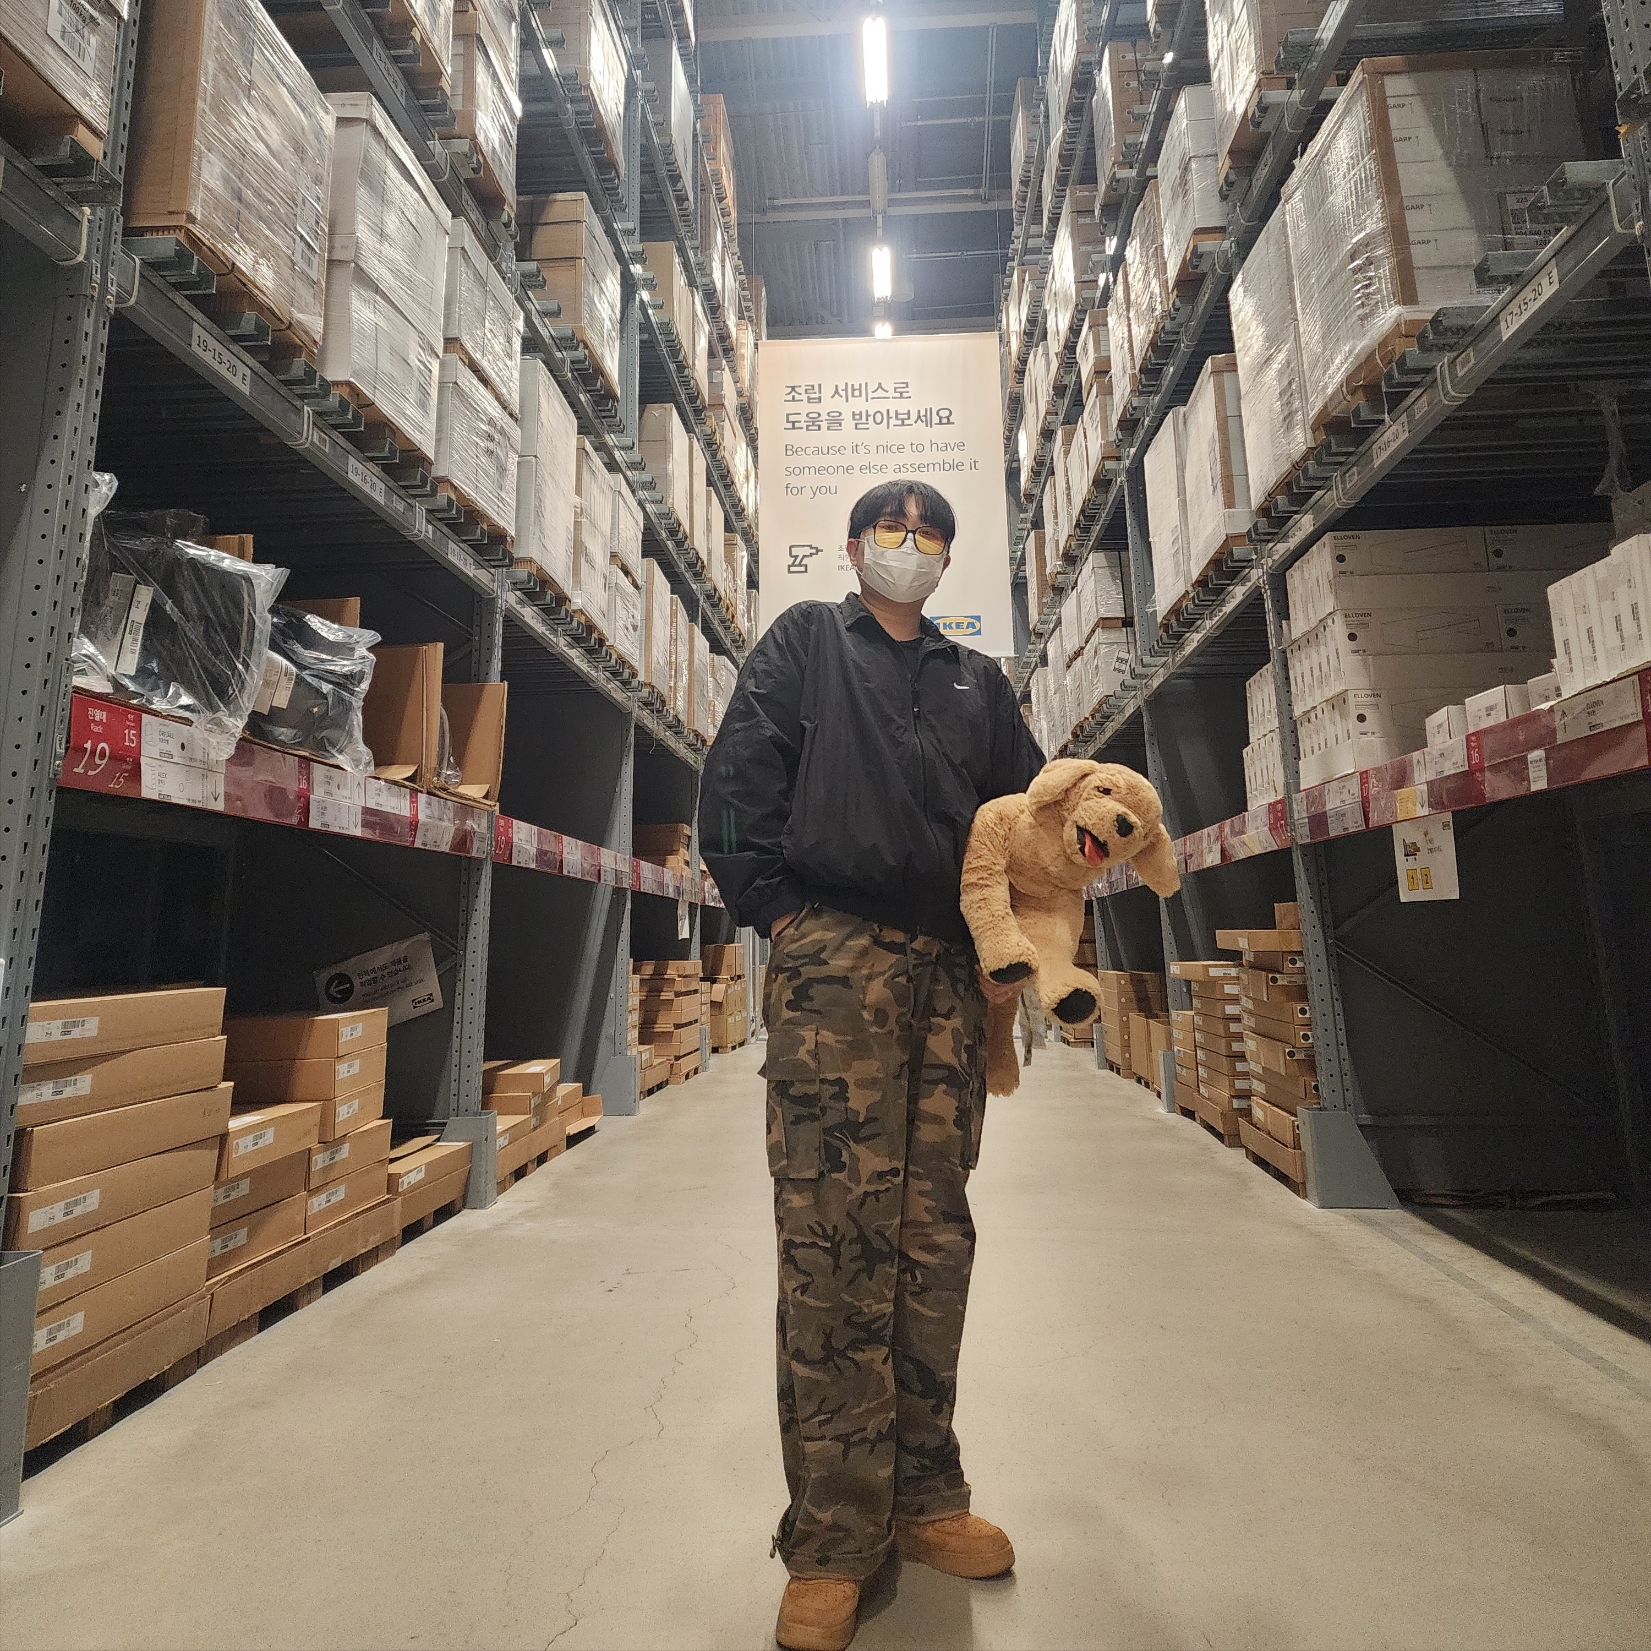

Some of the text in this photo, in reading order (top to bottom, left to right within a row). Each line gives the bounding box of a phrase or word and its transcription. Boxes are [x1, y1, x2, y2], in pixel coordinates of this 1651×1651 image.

[1387, 102, 1407, 110] GARP
[1404, 203, 1425, 211] GARP
[1409, 238, 1431, 246] GARP
[1504, 270, 1555, 330] 17-15-20 E
[197, 335, 247, 386] 19-15-20 E
[783, 381, 912, 404] 조립 서비스로
[783, 407, 955, 432] 도움을 받아보세요
[784, 438, 966, 457] Because it's nice to have
[784, 457, 979, 477] someone else assemble it
[350, 464, 377, 492] 19-16-20
[784, 483, 838, 499] for you
[88, 707, 107, 723] 진열대
[90, 723, 103, 734] Rack
[124, 729, 137, 747] 15
[73, 740, 110, 776] 19
[1471, 749, 1480, 764] 16
[108, 772, 129, 789] 15
[299, 776, 308, 789] 16
[496, 835, 506, 854] 19
